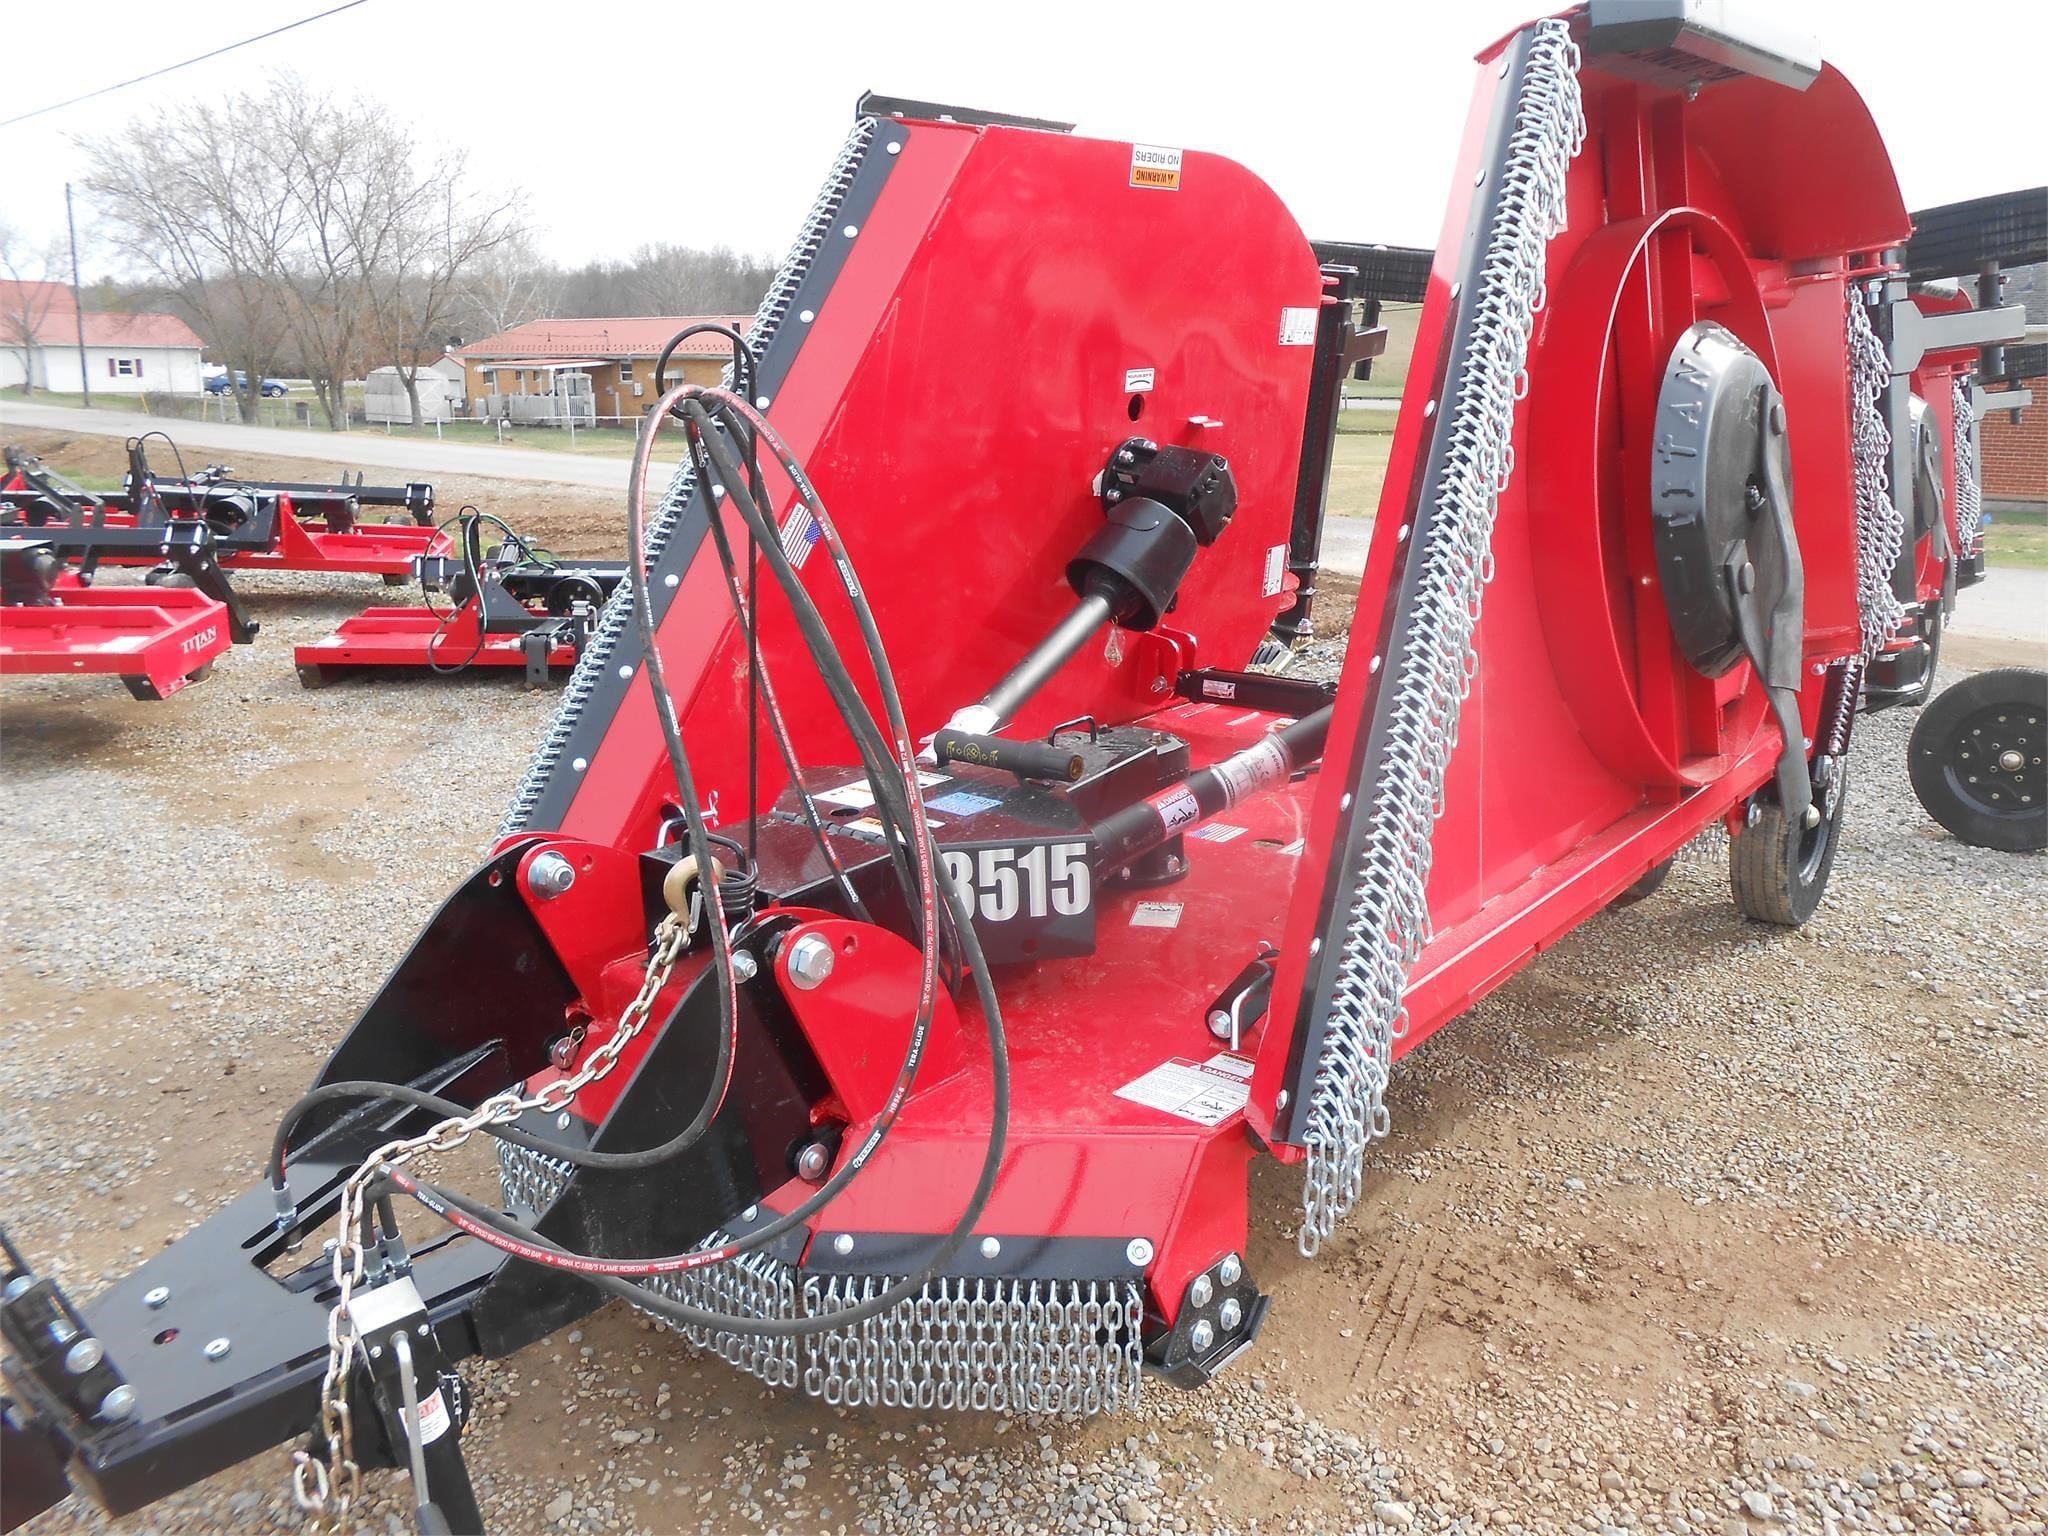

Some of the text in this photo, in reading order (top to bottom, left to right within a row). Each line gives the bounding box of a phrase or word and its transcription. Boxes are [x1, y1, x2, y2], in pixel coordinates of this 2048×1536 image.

[1135, 151, 1179, 164] NO RIDERS
[1136, 170, 1167, 183] WARNING
[788, 464, 813, 499] TERA-GLIDE
[181, 626, 216, 654] TITAN
[1164, 789, 1191, 804] DANGER
[913, 808, 923, 835] RESISTANT
[918, 836, 926, 854] FLAME
[907, 1025, 925, 1067] TERA-GLIDE
[1203, 1067, 1244, 1083] DANGER
[416, 1191, 445, 1214] TERA-GLIDE
